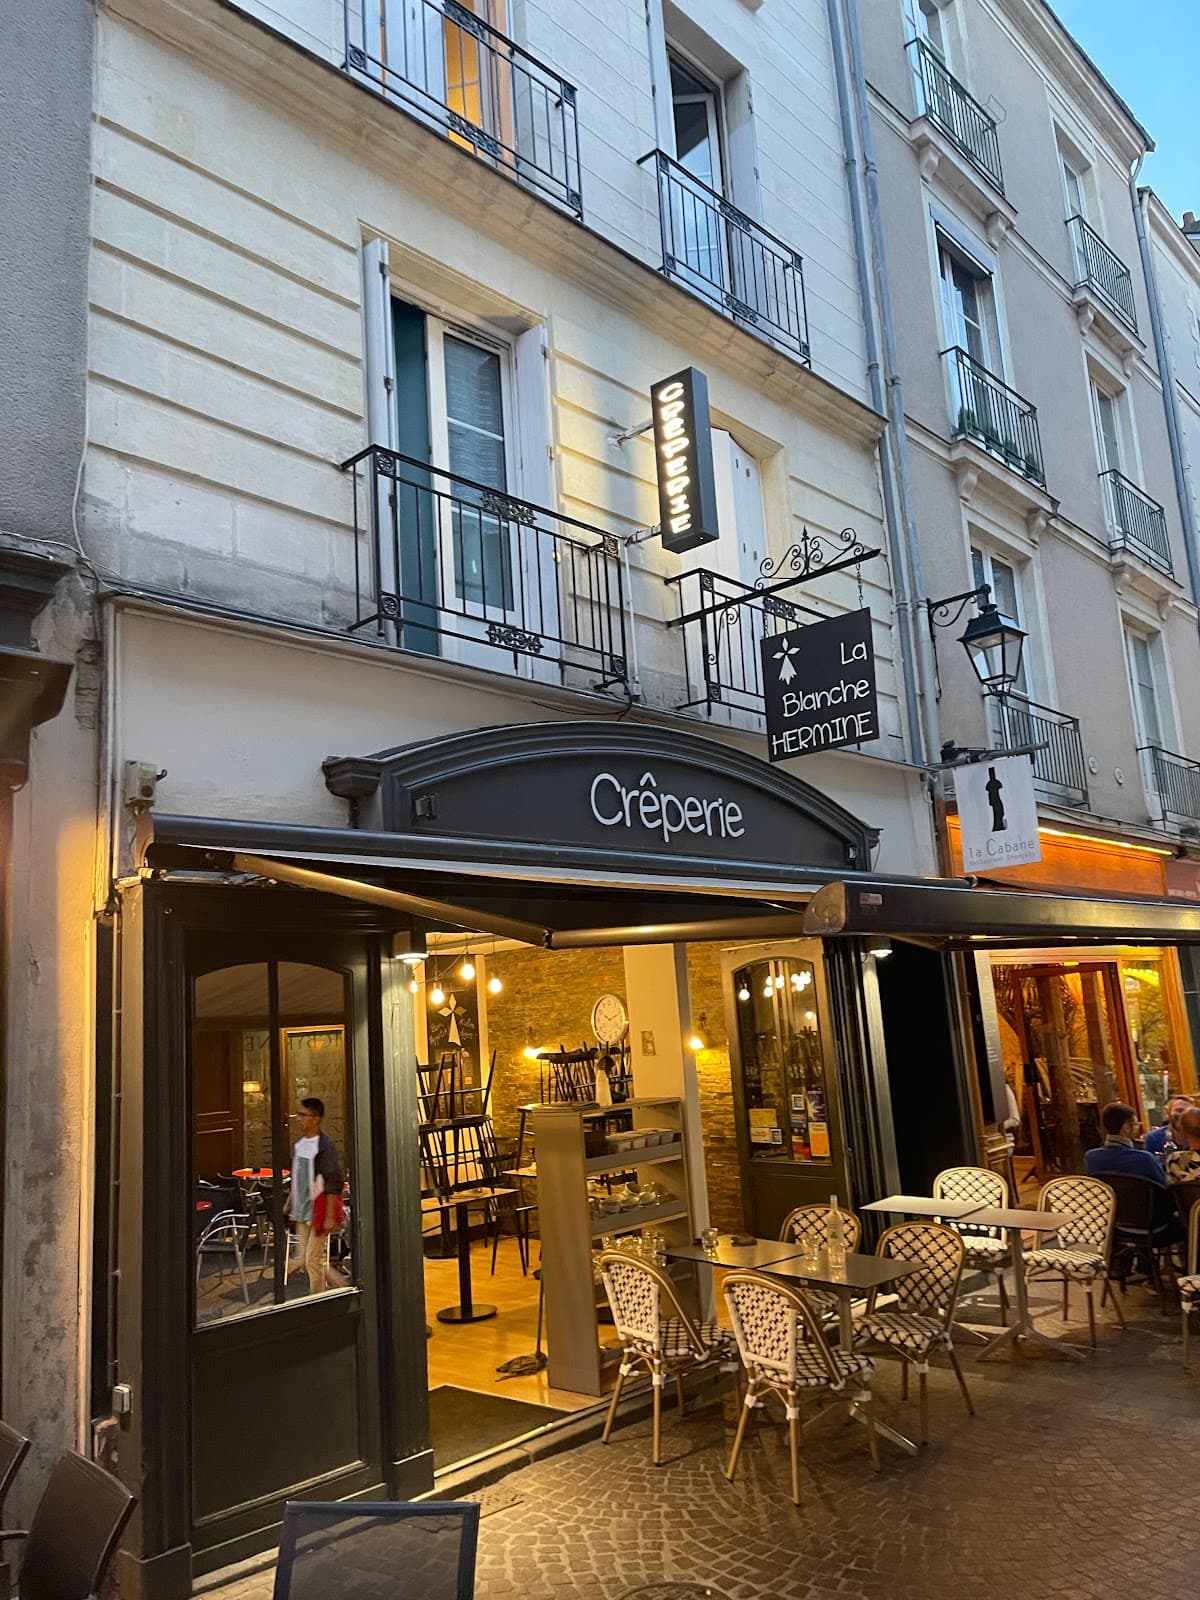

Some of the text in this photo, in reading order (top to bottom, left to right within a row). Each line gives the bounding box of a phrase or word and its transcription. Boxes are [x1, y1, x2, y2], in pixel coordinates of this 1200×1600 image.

[840, 641, 868, 665] La
[782, 679, 871, 718] Blanche
[771, 711, 874, 756] HERMINE
[590, 772, 745, 843] Crêperie
[986, 838, 1035, 857] Cabane
